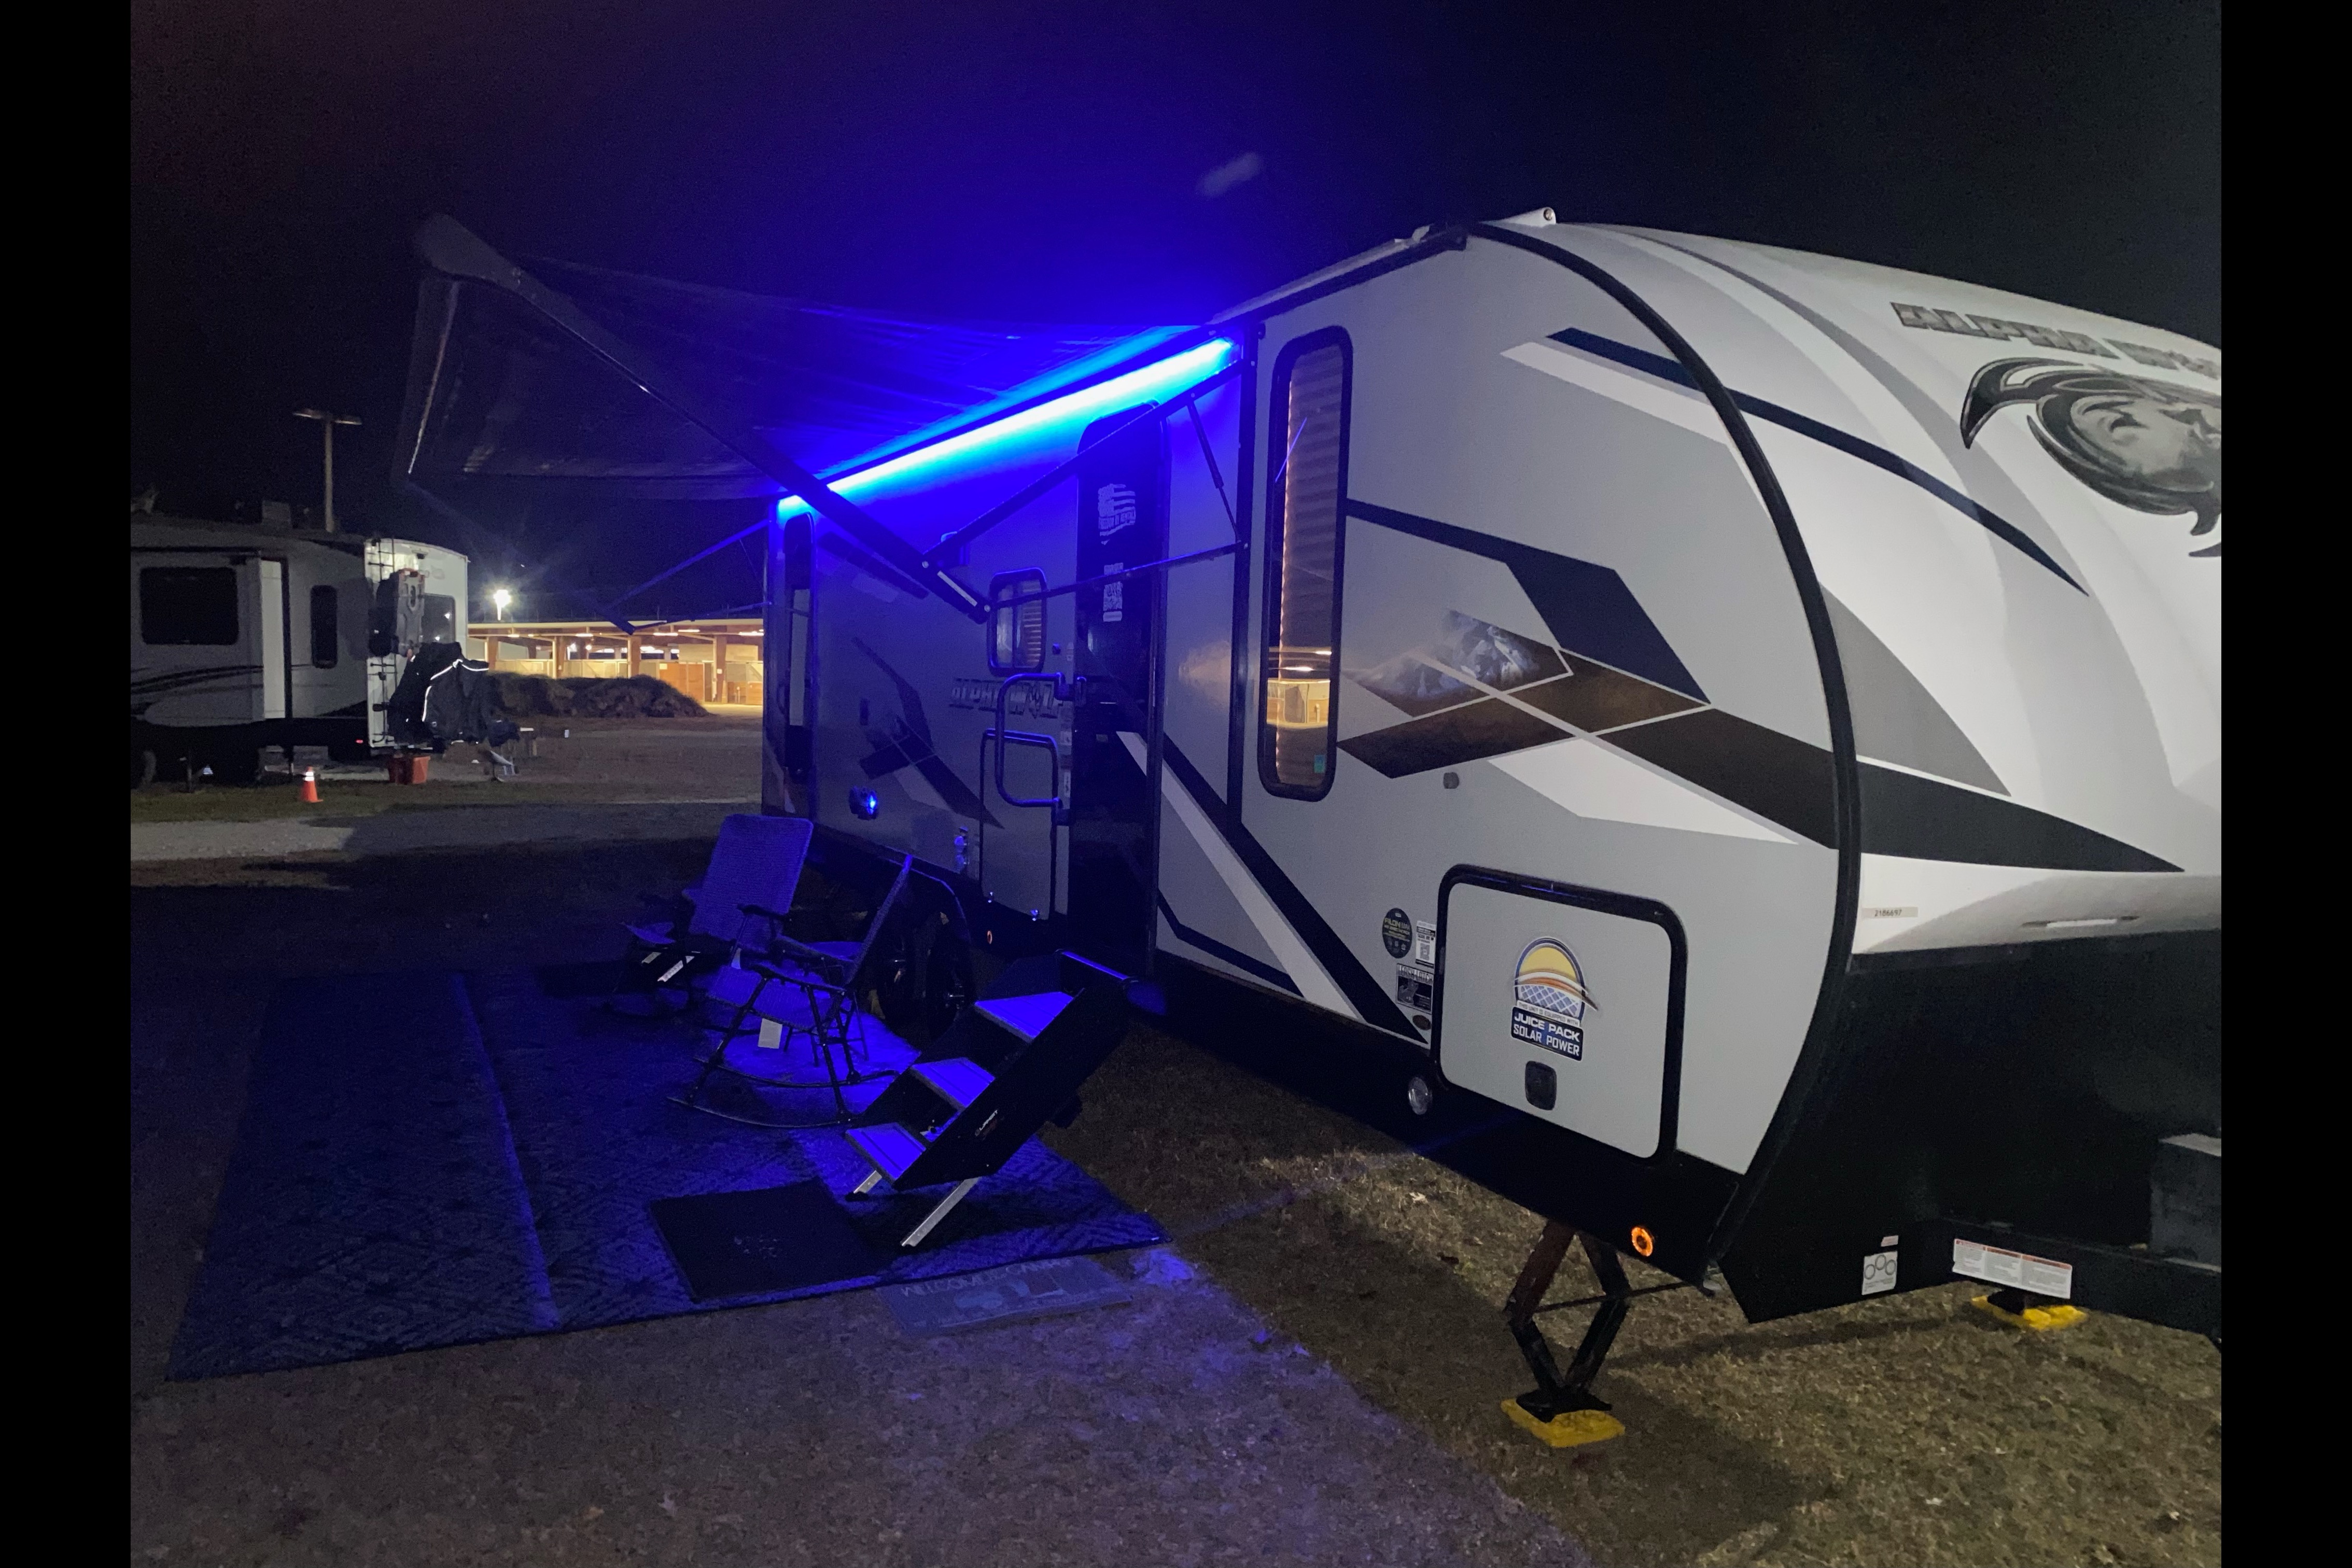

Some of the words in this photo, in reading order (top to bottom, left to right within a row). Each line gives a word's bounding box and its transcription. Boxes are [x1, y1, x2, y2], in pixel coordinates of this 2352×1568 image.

[1890, 302, 2122, 360] ALPHA
[1513, 1023, 1542, 1043] SOLAR
[1546, 1034, 1579, 1056] POWER
[1514, 1012, 1545, 1030] JUICE
[1548, 1023, 1580, 1042] PACK
